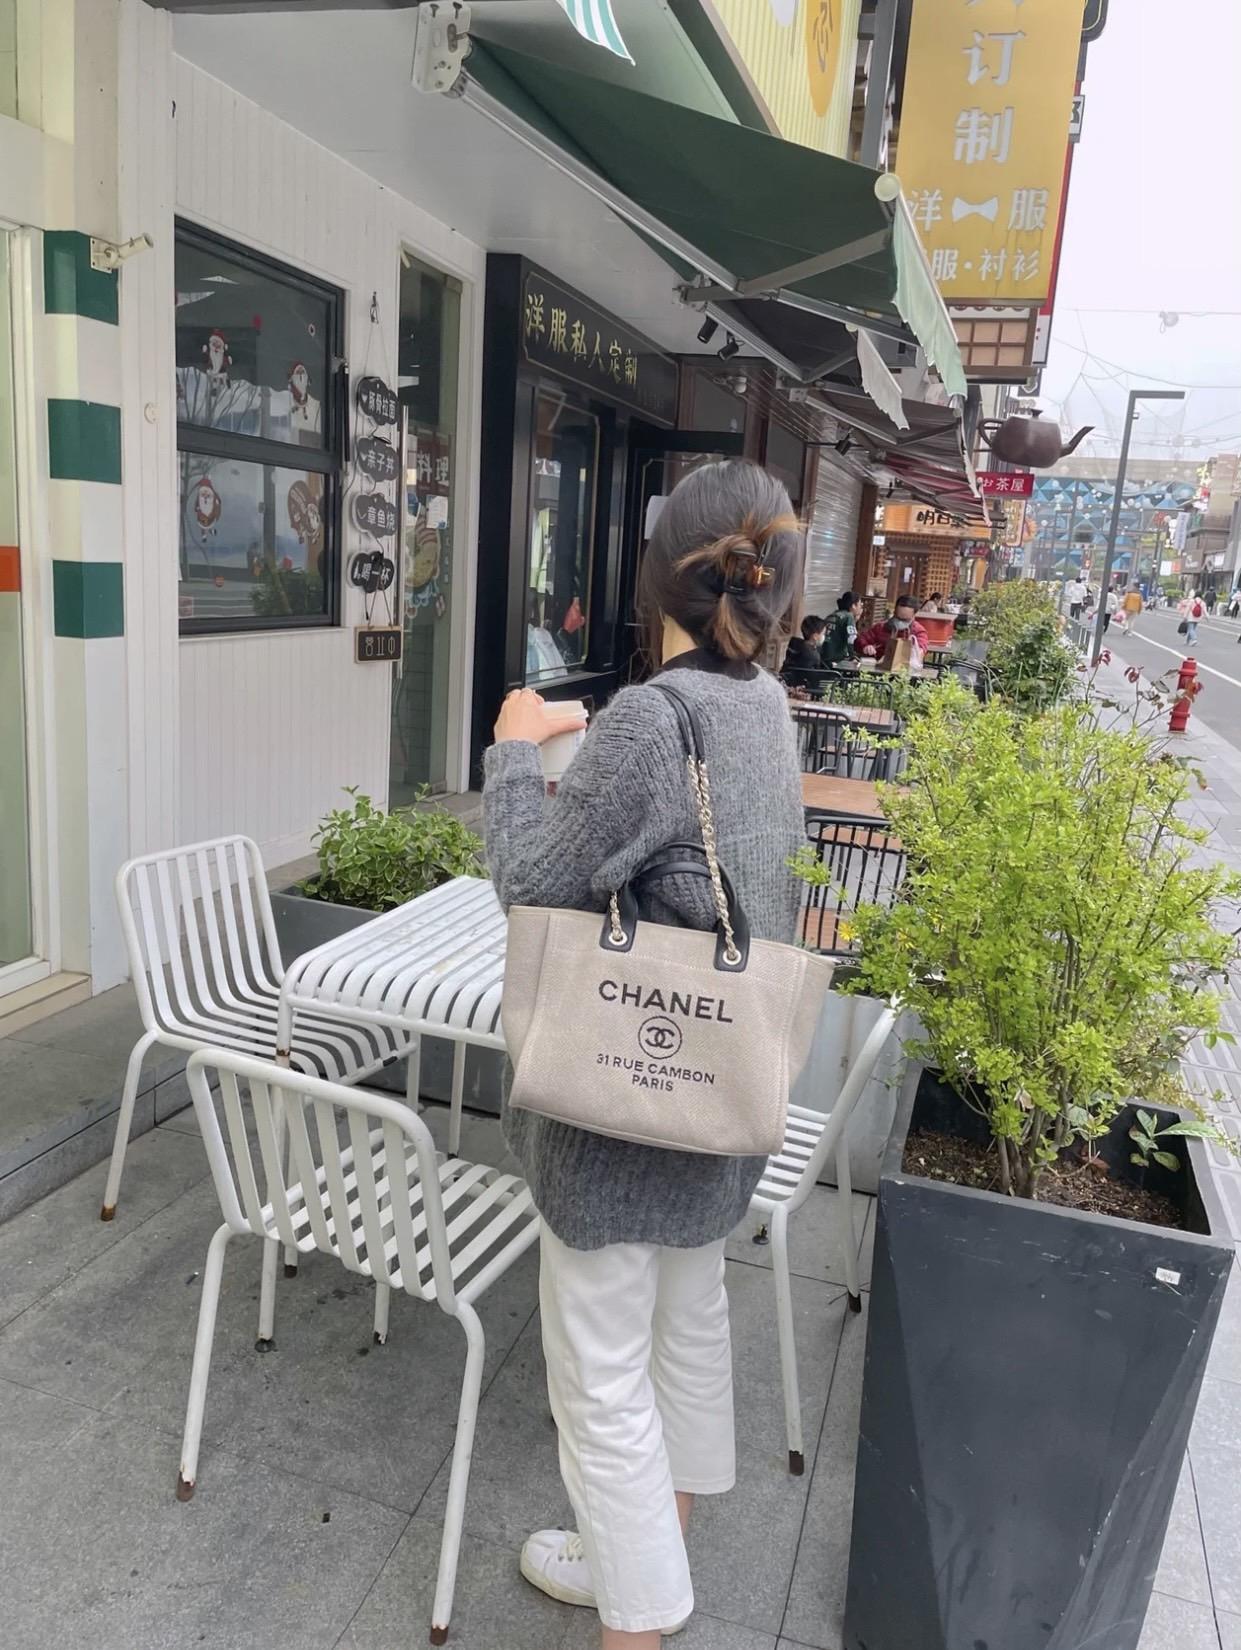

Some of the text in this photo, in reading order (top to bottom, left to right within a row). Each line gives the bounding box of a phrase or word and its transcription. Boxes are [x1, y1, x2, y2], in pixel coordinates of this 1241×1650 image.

[598, 979, 733, 1023] CHANEL
[596, 1053, 715, 1085] 31 RUE CAMBON
[631, 1073, 674, 1092] PARIS
